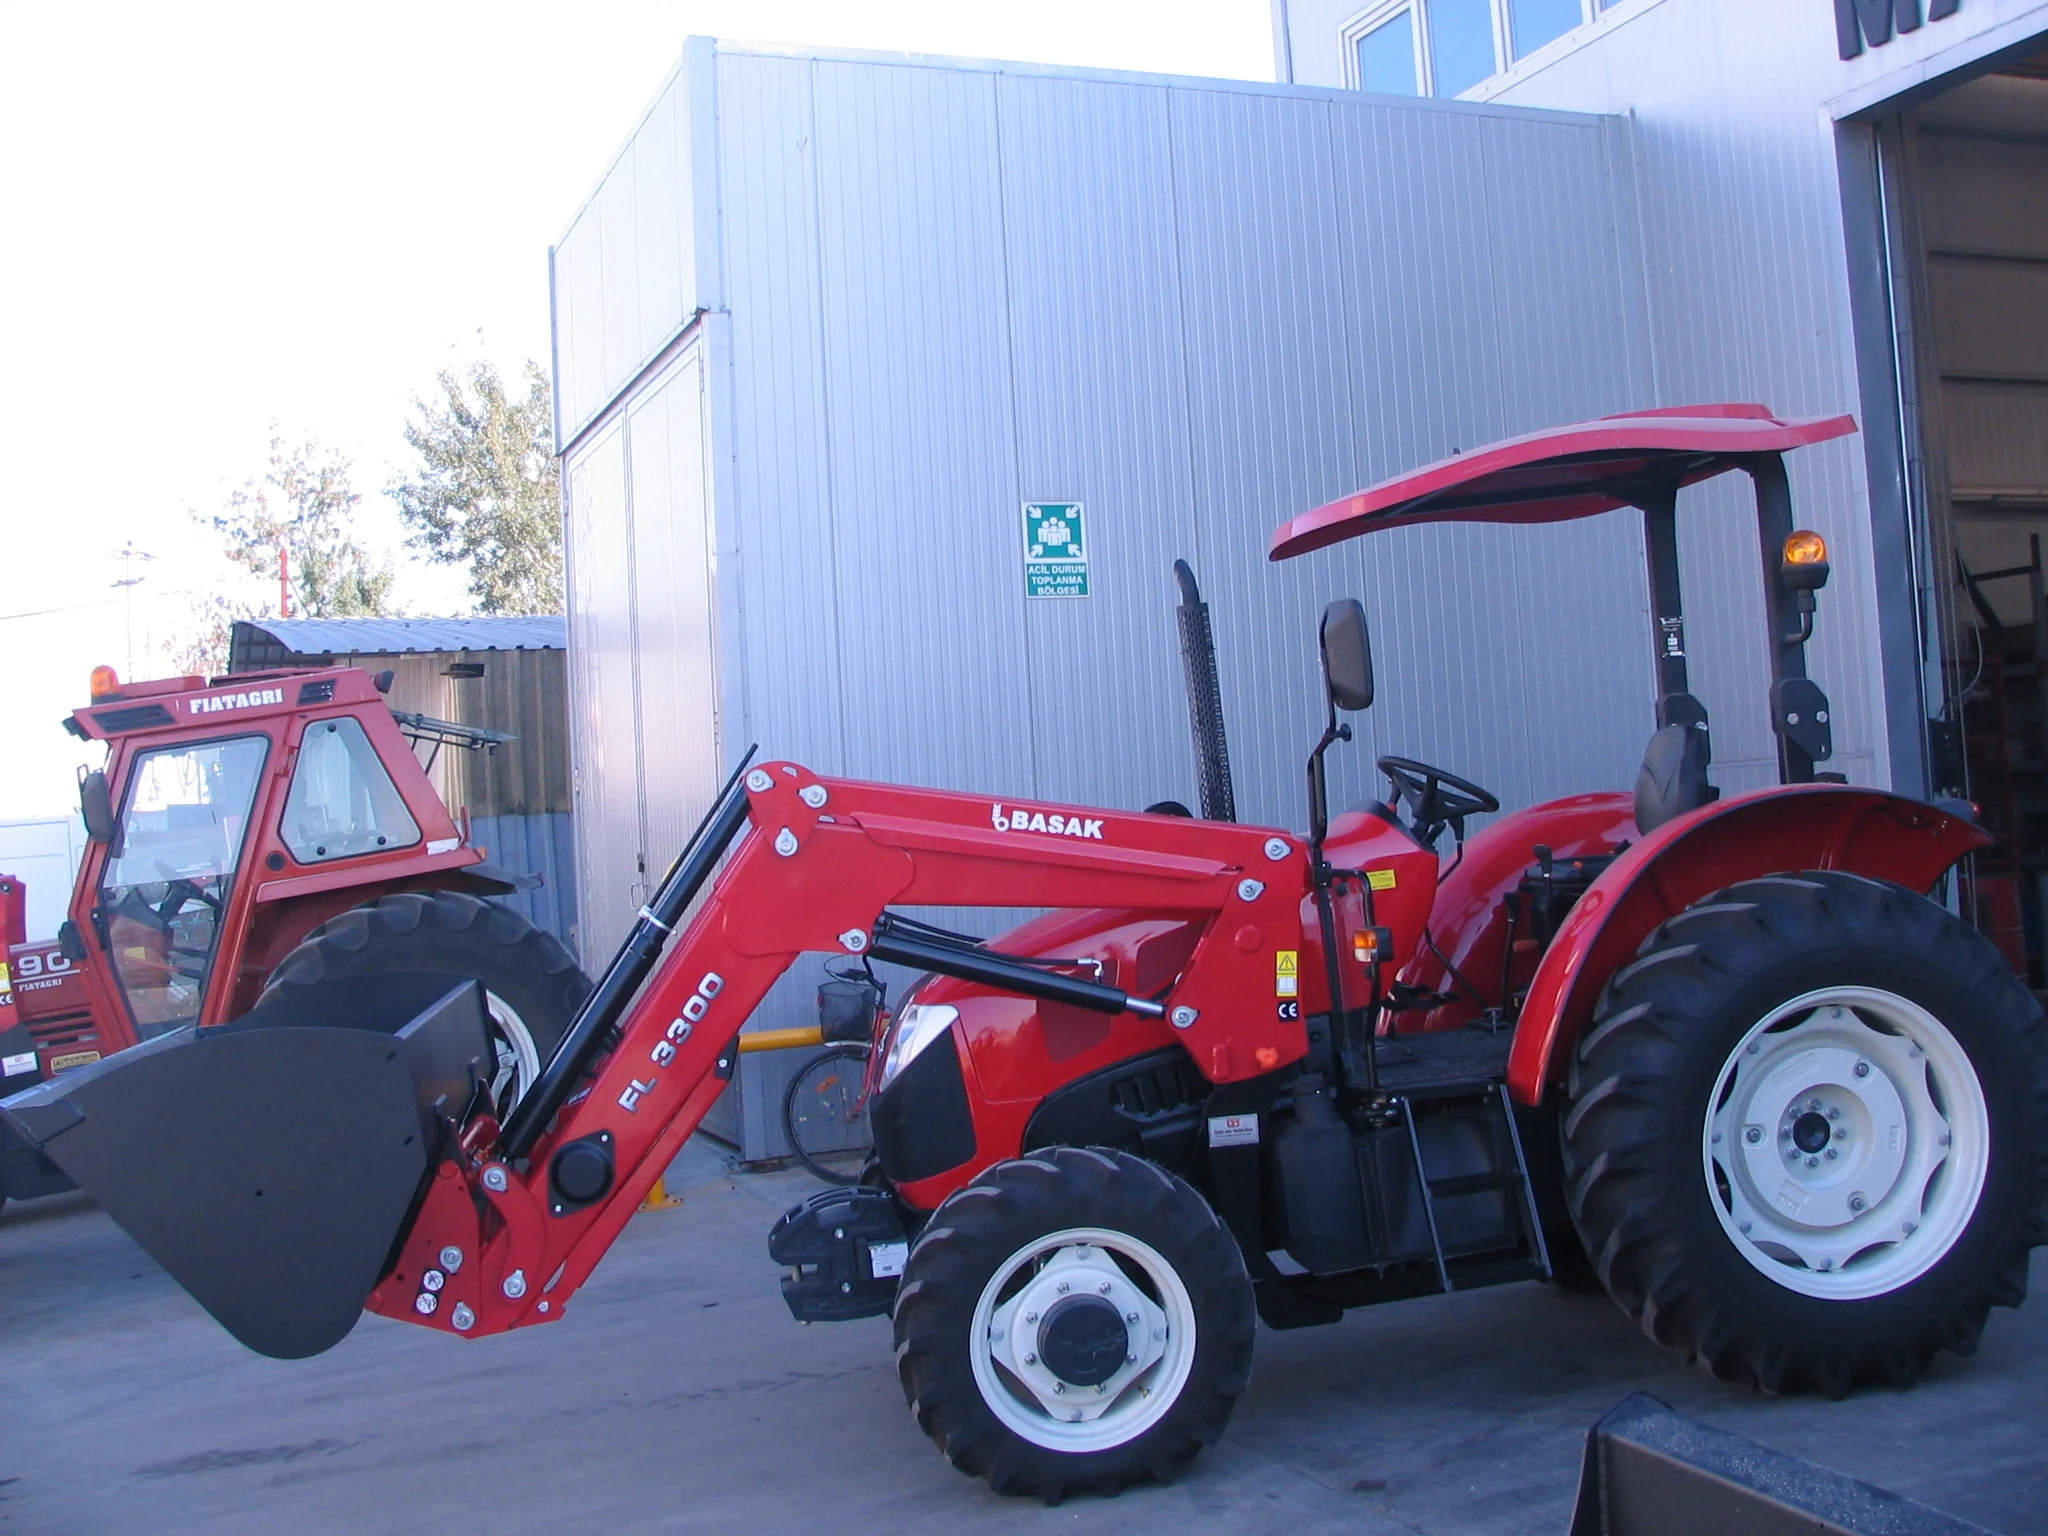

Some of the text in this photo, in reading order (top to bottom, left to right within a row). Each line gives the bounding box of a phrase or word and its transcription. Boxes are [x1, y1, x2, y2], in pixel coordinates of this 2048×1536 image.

[1051, 564, 1086, 575] DURUM
[1031, 576, 1084, 585] TOPLANMA
[1037, 585, 1080, 596] BÖLGESİ
[189, 688, 284, 714] FIATAGRI
[18, 978, 63, 992] FIATAGRI
[617, 971, 726, 1114] FL 3300
